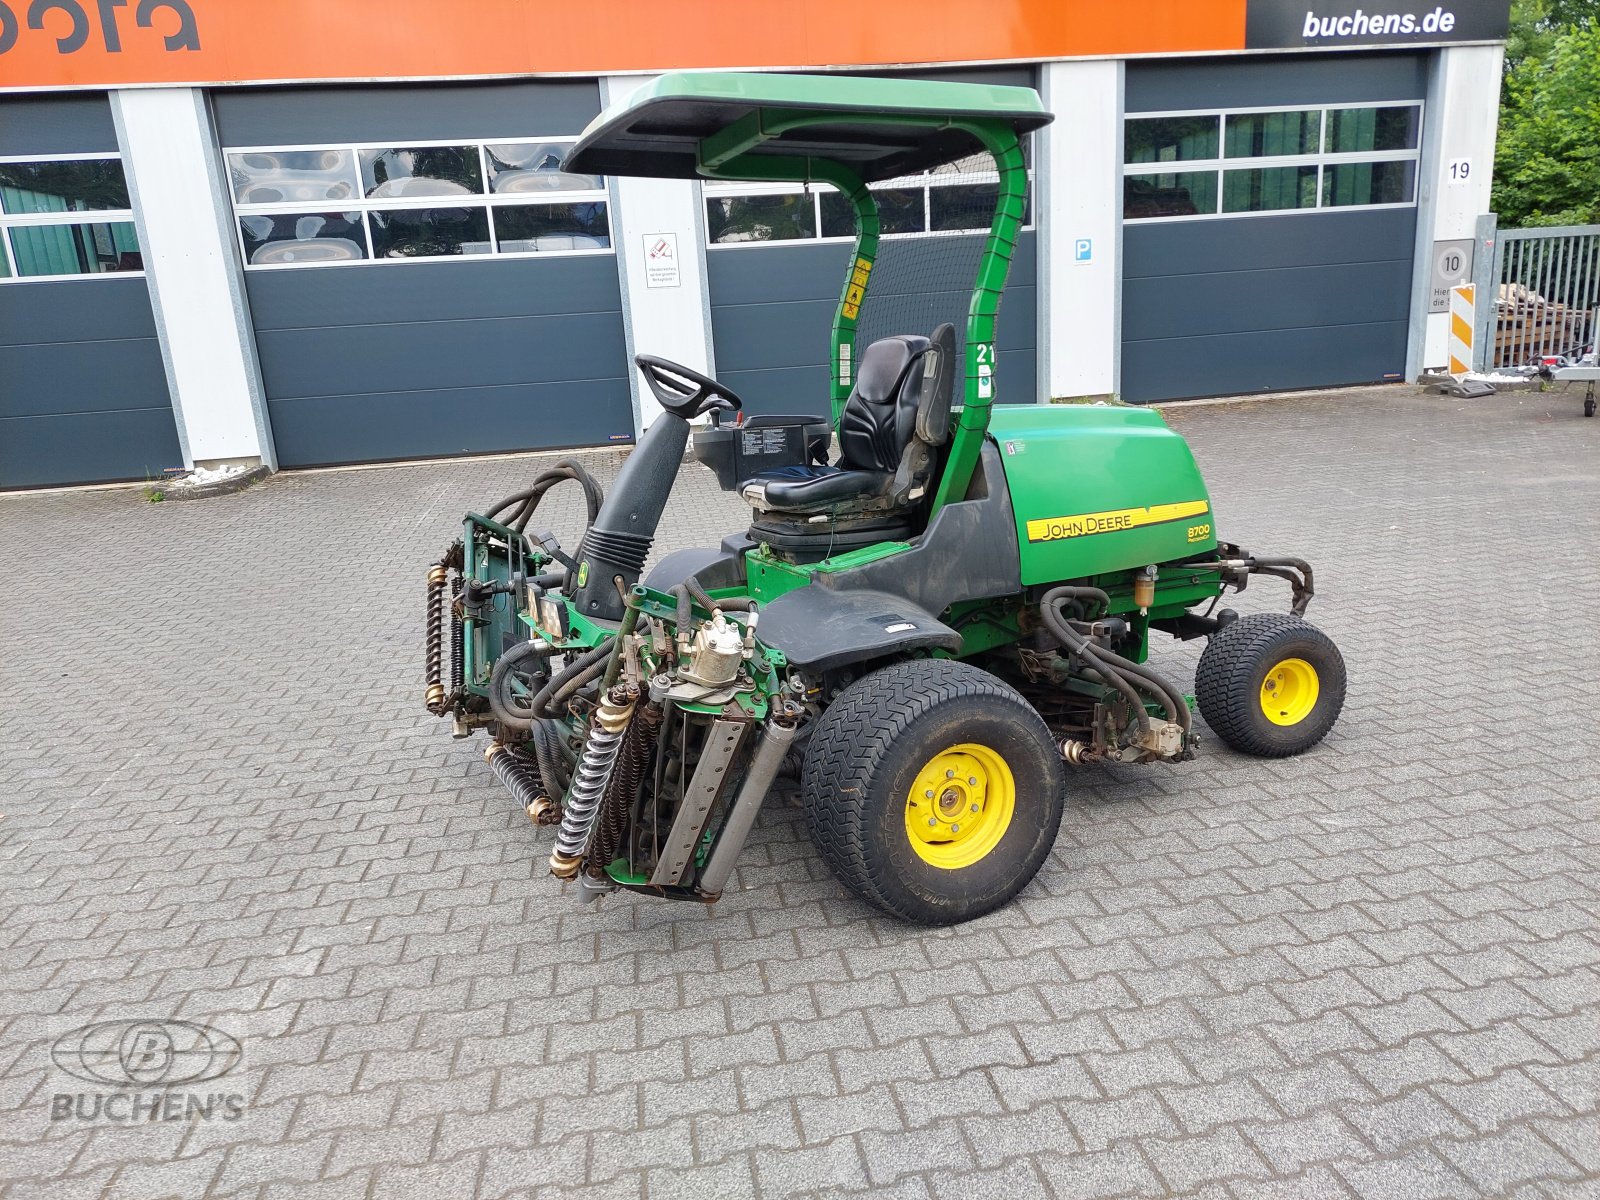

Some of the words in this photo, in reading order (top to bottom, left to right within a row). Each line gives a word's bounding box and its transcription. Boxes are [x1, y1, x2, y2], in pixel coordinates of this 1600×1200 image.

[1302, 7, 1455, 37] buchens.de
[1450, 162, 1470, 180] 19
[1077, 240, 1090, 259] P
[1445, 256, 1460, 272] 10
[1434, 288, 1450, 296] Hier
[1433, 298, 1444, 306] die
[976, 343, 995, 363] 21
[1042, 521, 1083, 539] JOHN
[1086, 514, 1132, 532] DEERE
[1187, 524, 1210, 538] 8700
